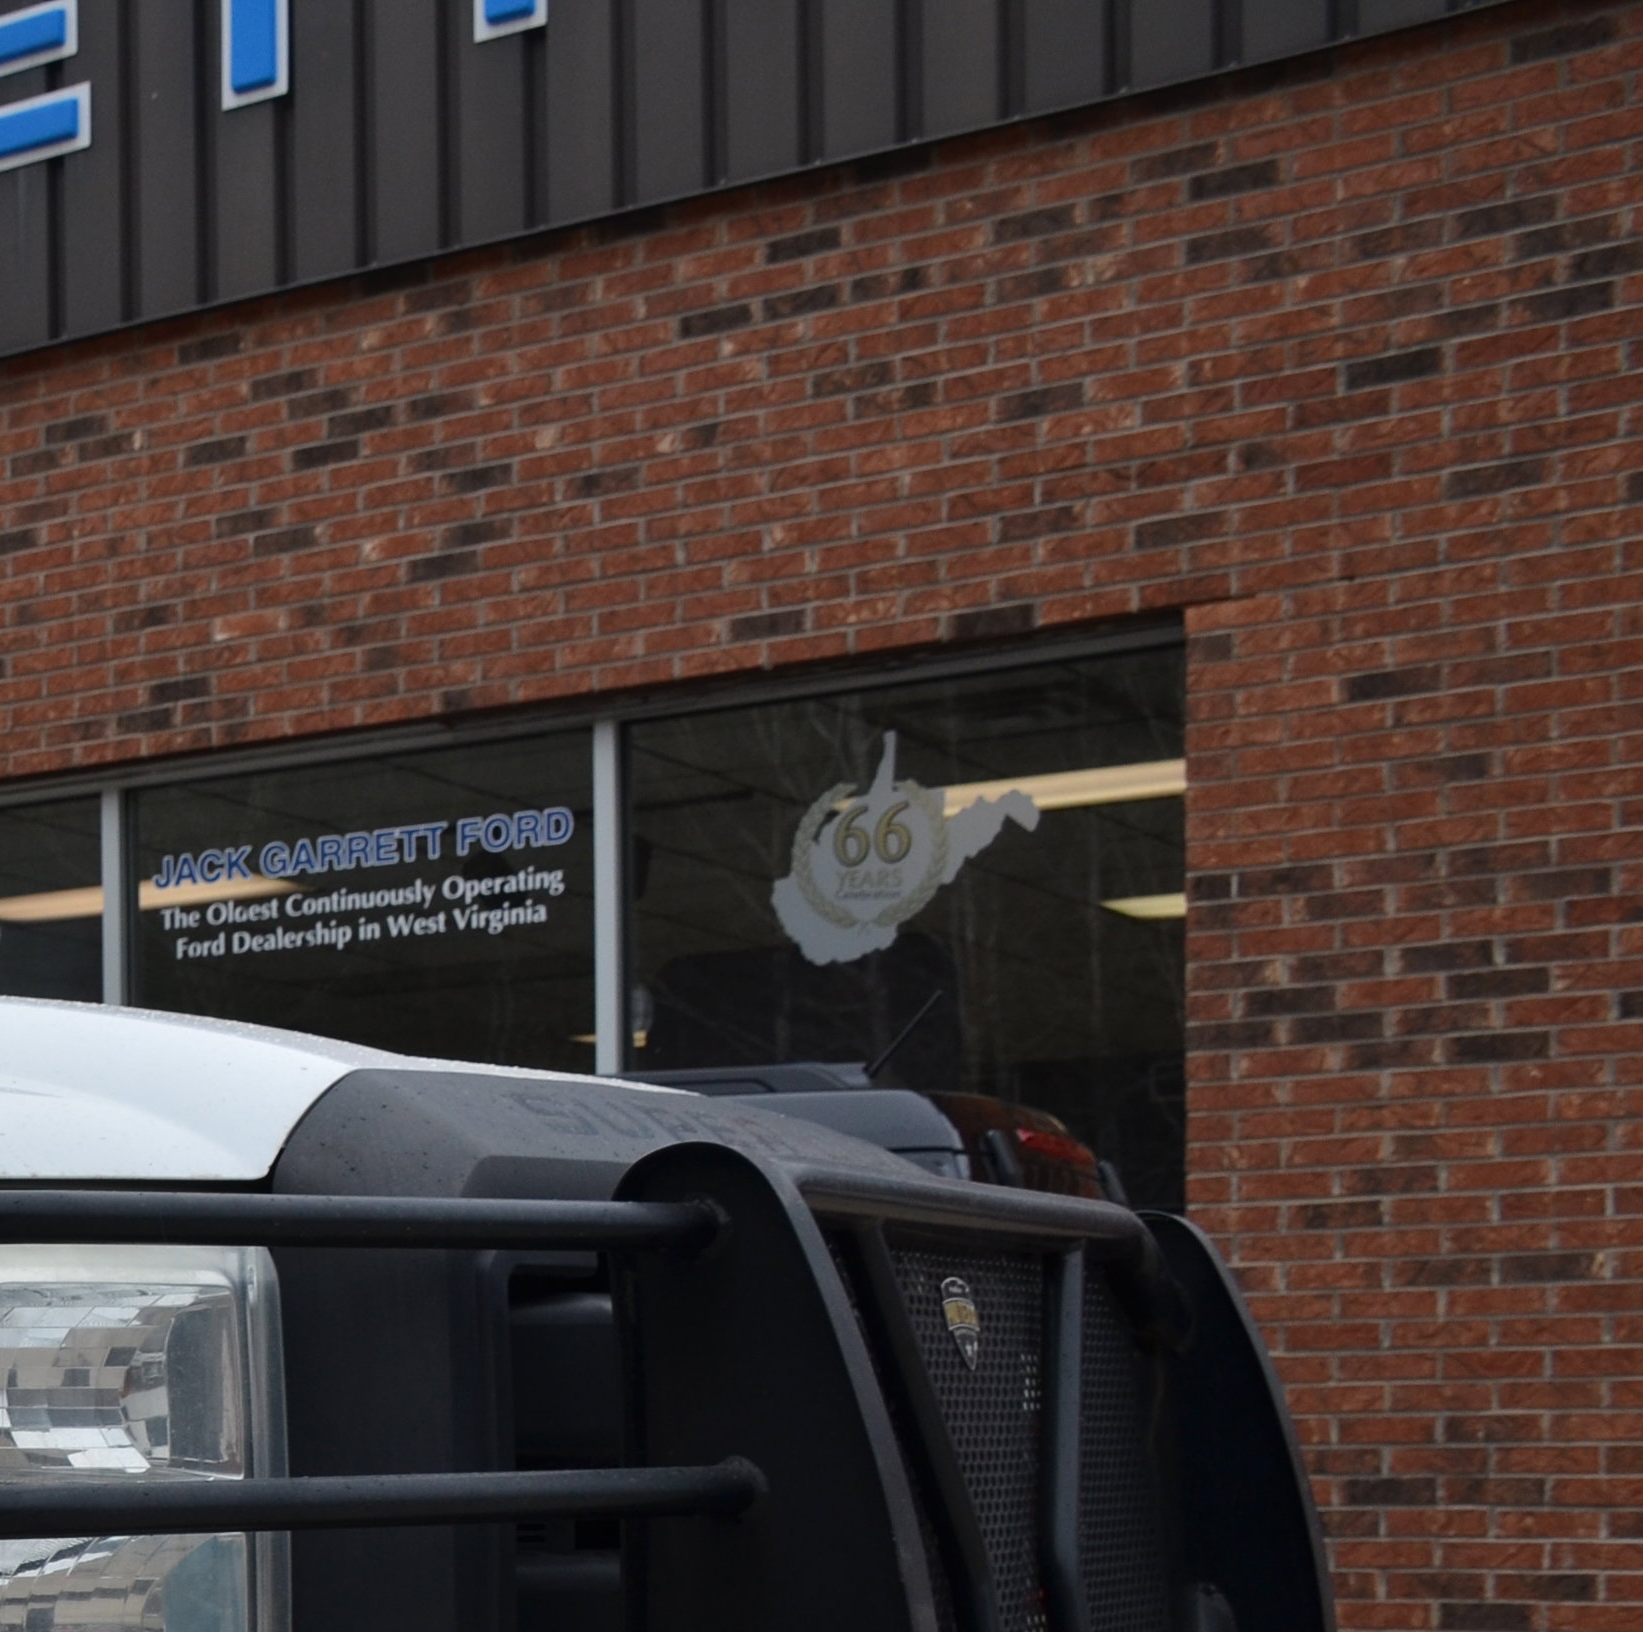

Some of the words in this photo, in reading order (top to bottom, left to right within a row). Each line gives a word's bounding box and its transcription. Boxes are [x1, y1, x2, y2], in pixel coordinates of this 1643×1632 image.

[152, 844, 253, 890] JACK
[259, 821, 448, 880] GARRETT
[455, 806, 575, 857] FORD
[833, 801, 912, 868] 66
[161, 908, 202, 932] The
[284, 878, 436, 921] Continuously
[441, 865, 565, 904] Operating
[175, 935, 225, 960] Ford
[232, 918, 353, 955] Dealership
[358, 918, 380, 941] in
[387, 911, 447, 938] West
[452, 901, 548, 936] Virginia
